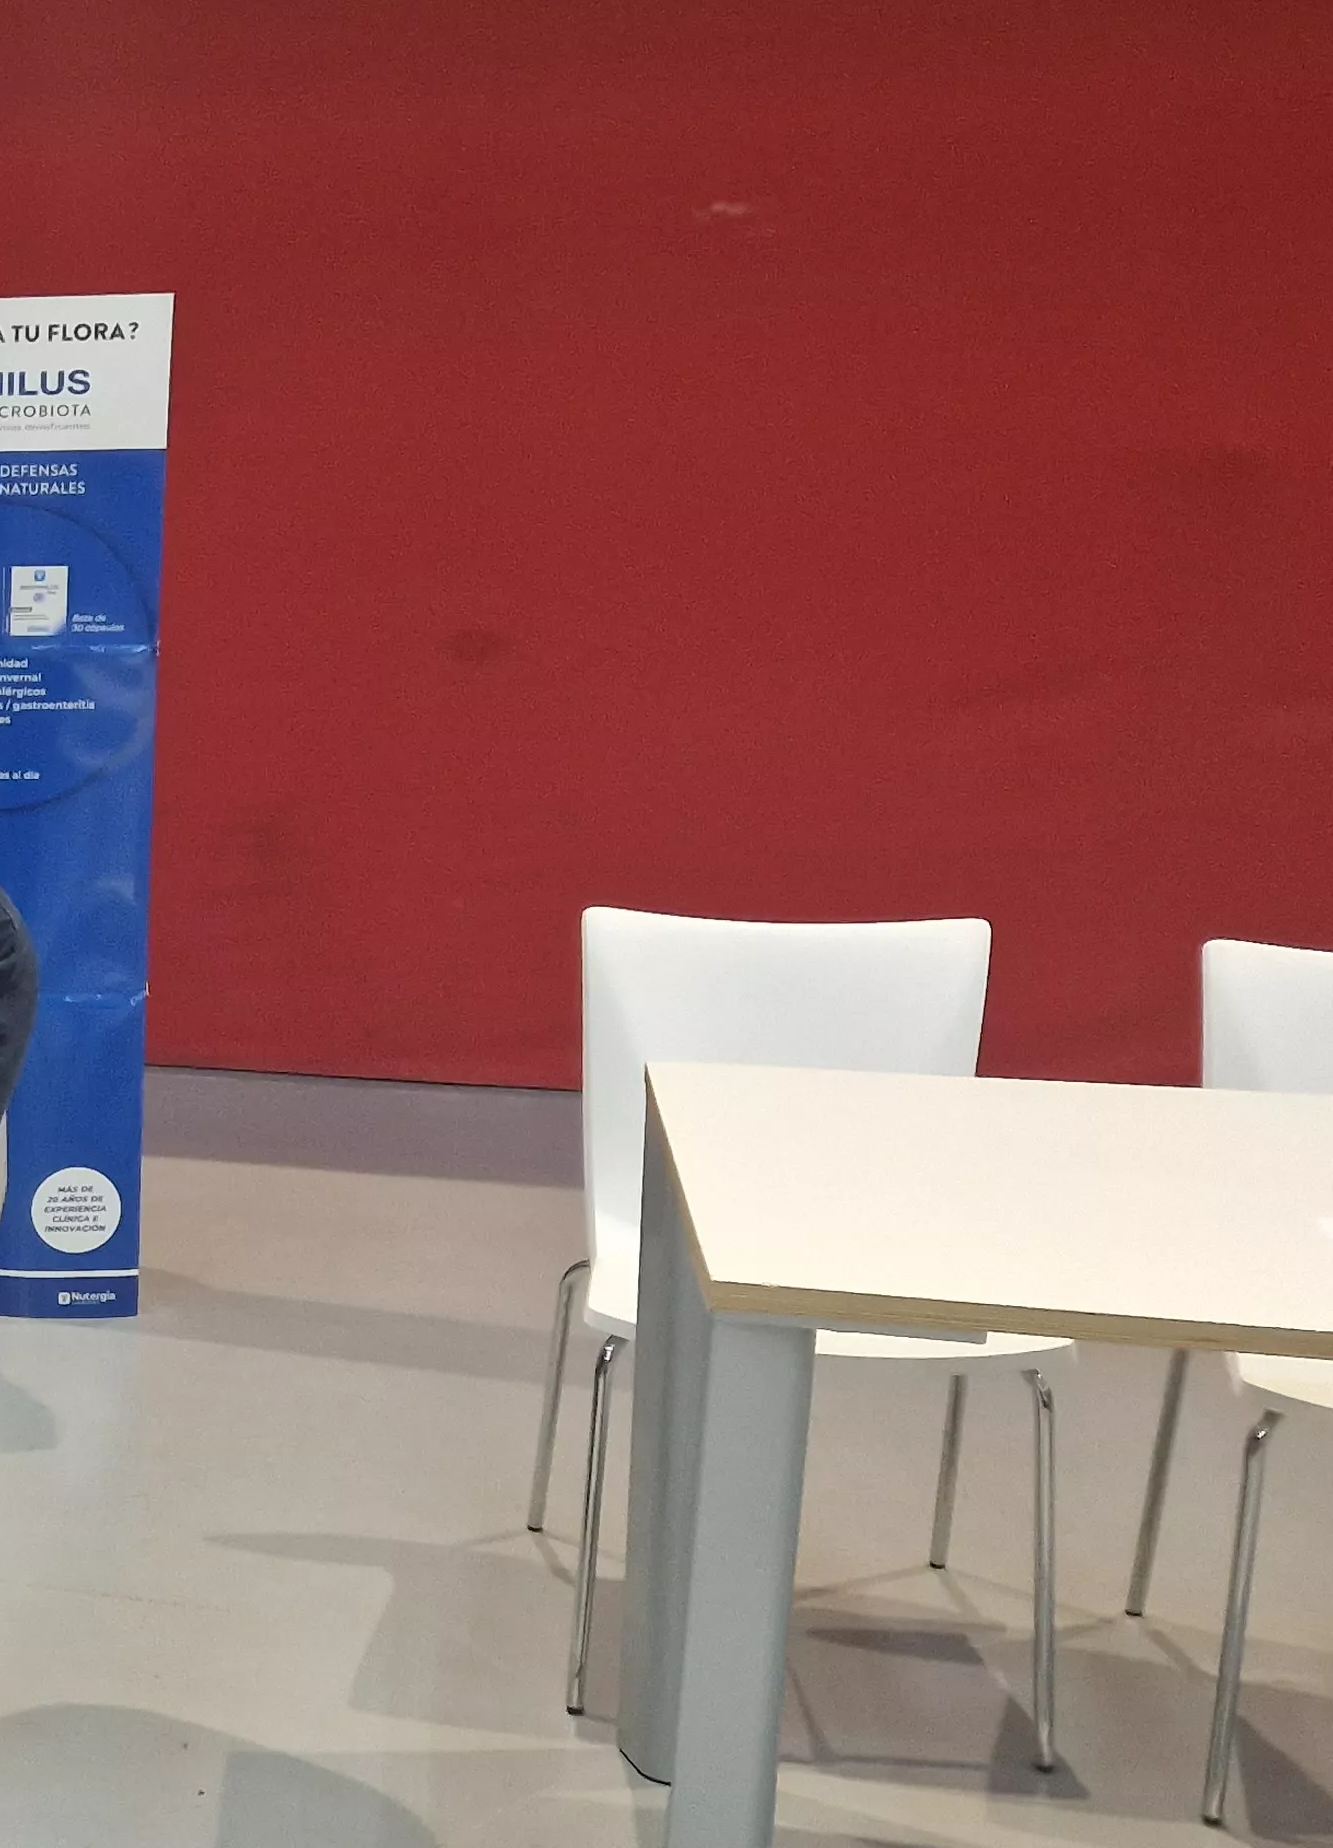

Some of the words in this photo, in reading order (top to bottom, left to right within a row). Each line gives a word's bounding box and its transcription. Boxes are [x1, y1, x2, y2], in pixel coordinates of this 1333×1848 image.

[11, 323, 40, 343] TU
[0, 463, 79, 478] DEFENSAS
[81, 1185, 94, 1193] DE
[91, 1195, 104, 1203] DE
[44, 1204, 107, 1213] EXPERIENCIA
[71, 1290, 116, 1303] Nutergia
